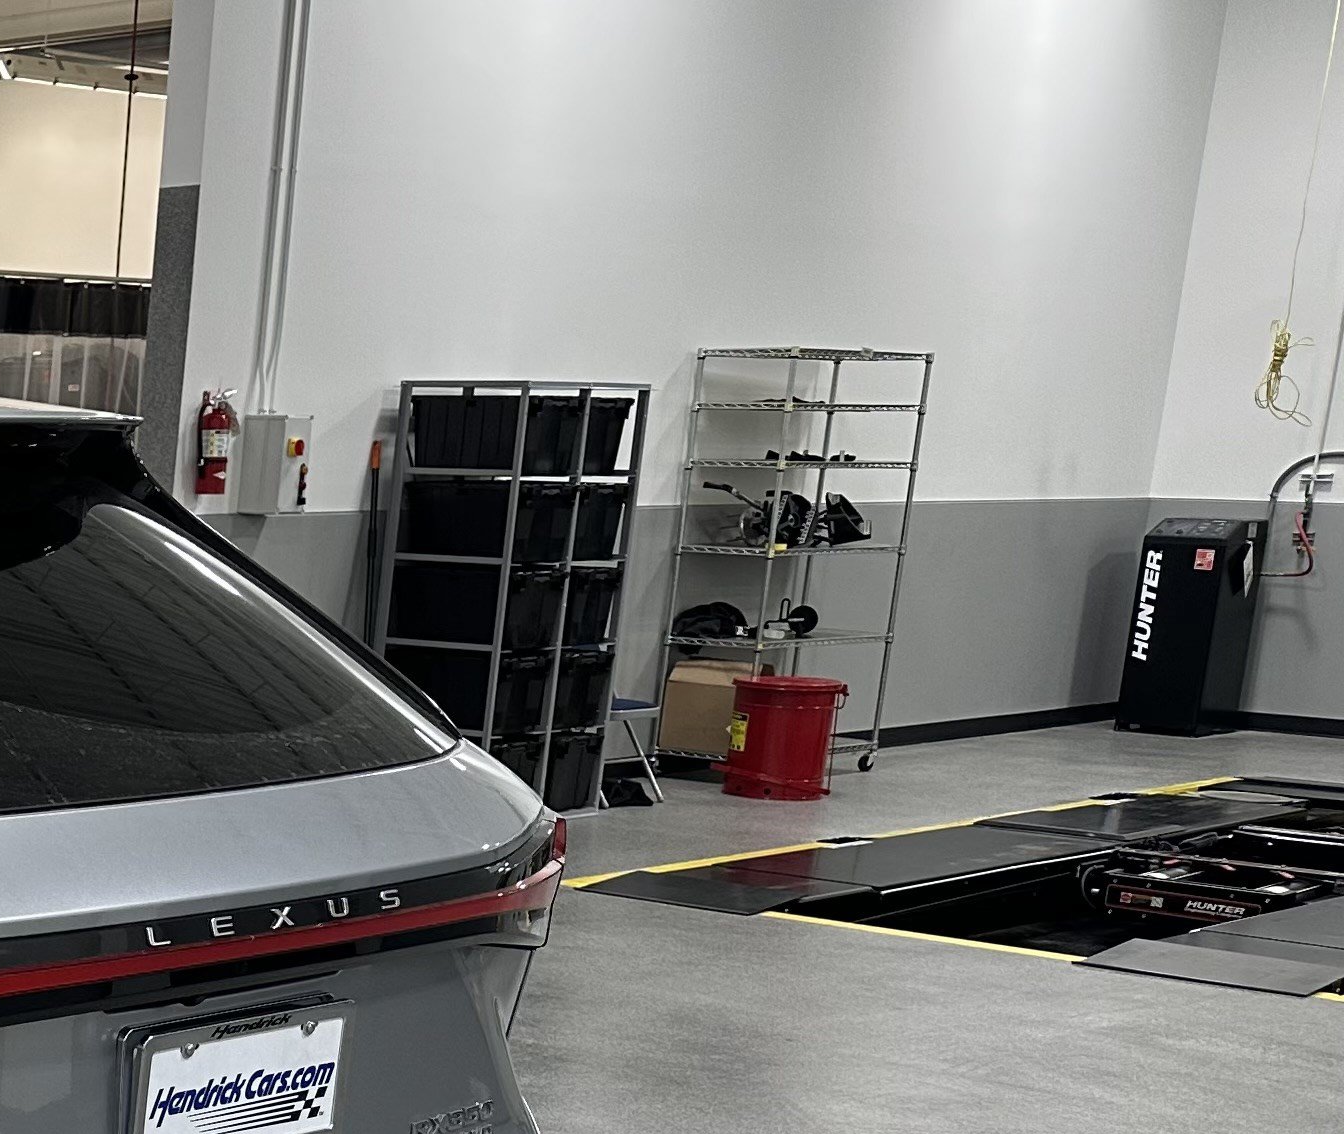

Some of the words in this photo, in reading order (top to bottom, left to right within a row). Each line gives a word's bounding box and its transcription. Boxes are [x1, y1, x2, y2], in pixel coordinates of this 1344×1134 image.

[1131, 549, 1163, 661] HUNTER
[145, 888, 402, 948] LEXUS
[1186, 900, 1246, 915] HUNTER
[210, 1013, 293, 1040] Hendrick
